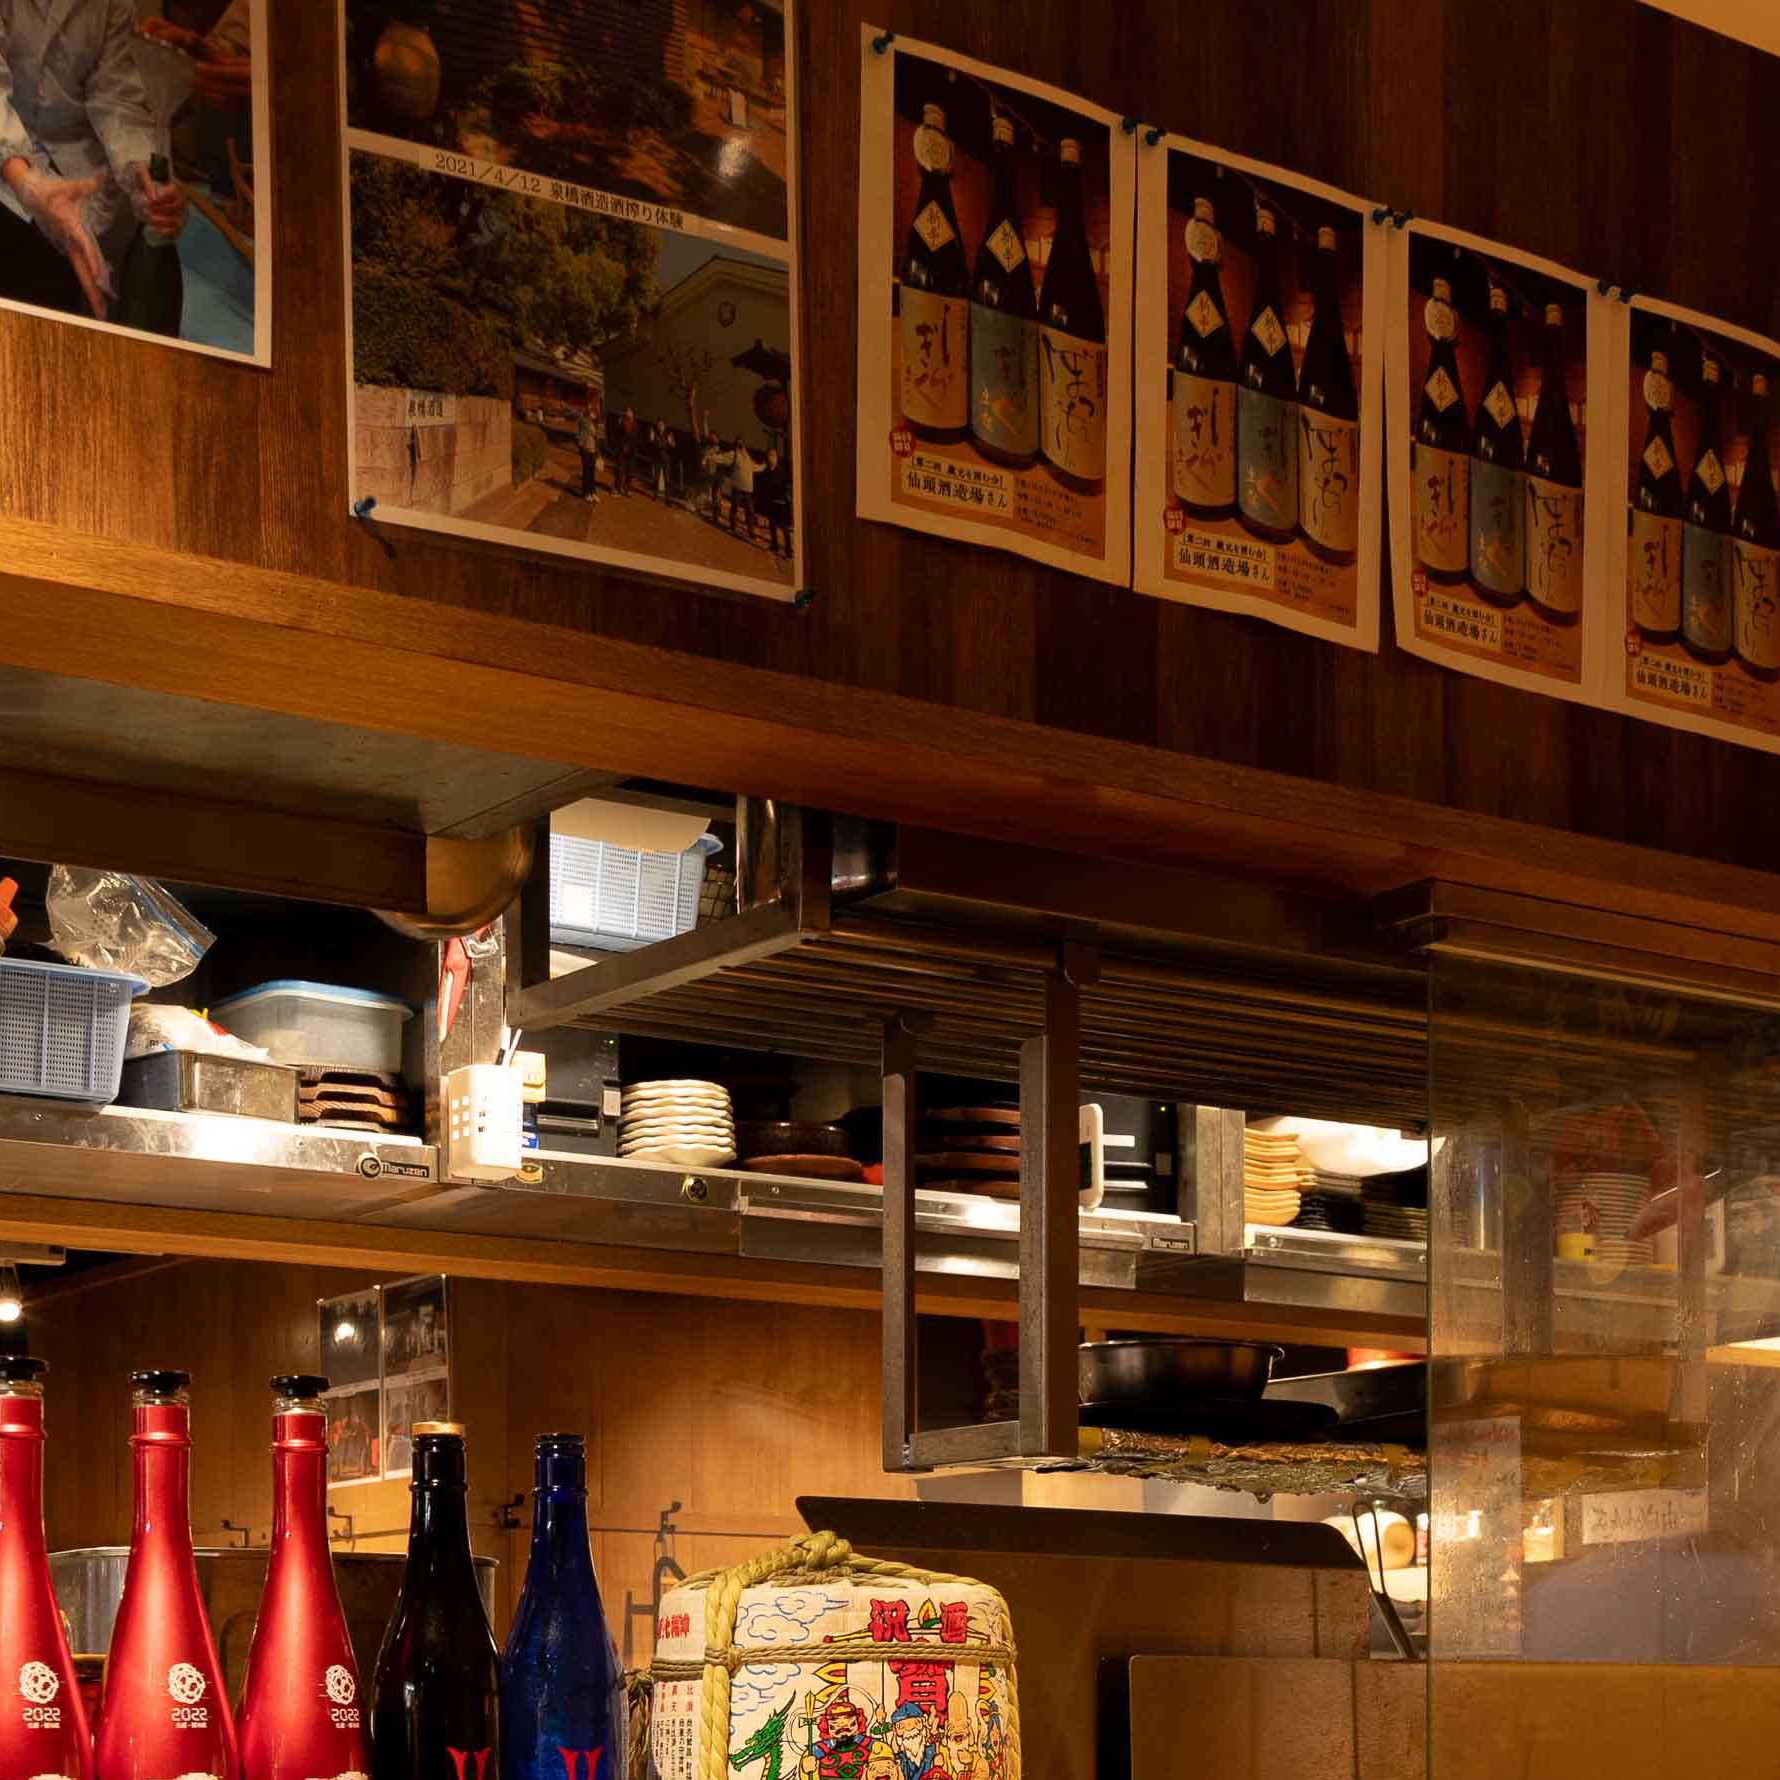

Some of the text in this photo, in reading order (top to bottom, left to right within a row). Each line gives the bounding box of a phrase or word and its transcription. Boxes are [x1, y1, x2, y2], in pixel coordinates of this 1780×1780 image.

[381, 1162, 429, 1177] Maruzen
[22, 1707, 61, 1721] 2022
[171, 1707, 208, 1721] 2022
